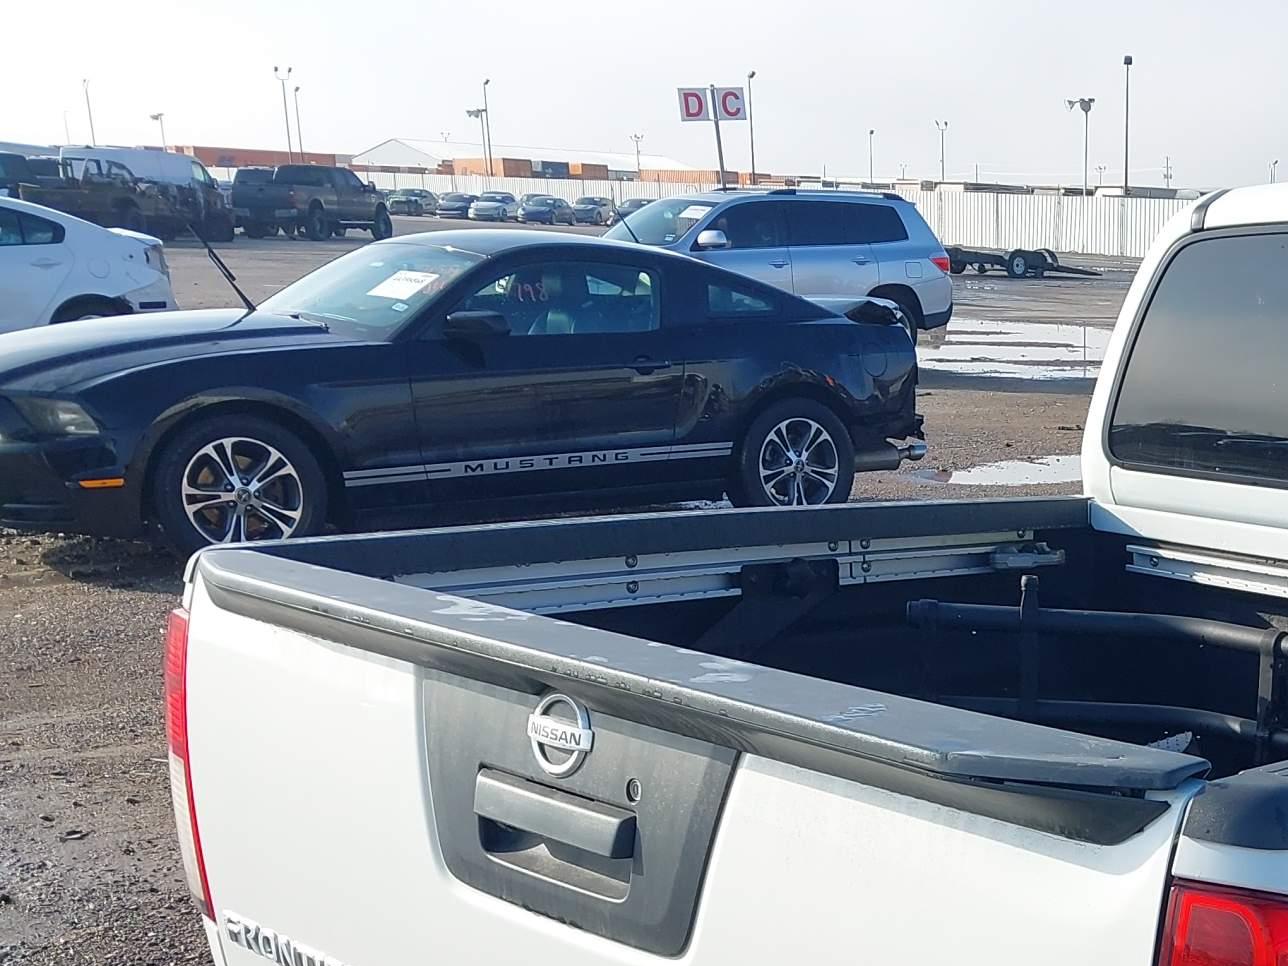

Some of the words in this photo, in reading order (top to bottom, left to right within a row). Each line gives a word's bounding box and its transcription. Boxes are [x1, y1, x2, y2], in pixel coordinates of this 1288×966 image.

[682, 92, 703, 118] D
[721, 91, 741, 117] C
[463, 451, 629, 474] MUSTANG
[530, 720, 582, 746] NISSAN
